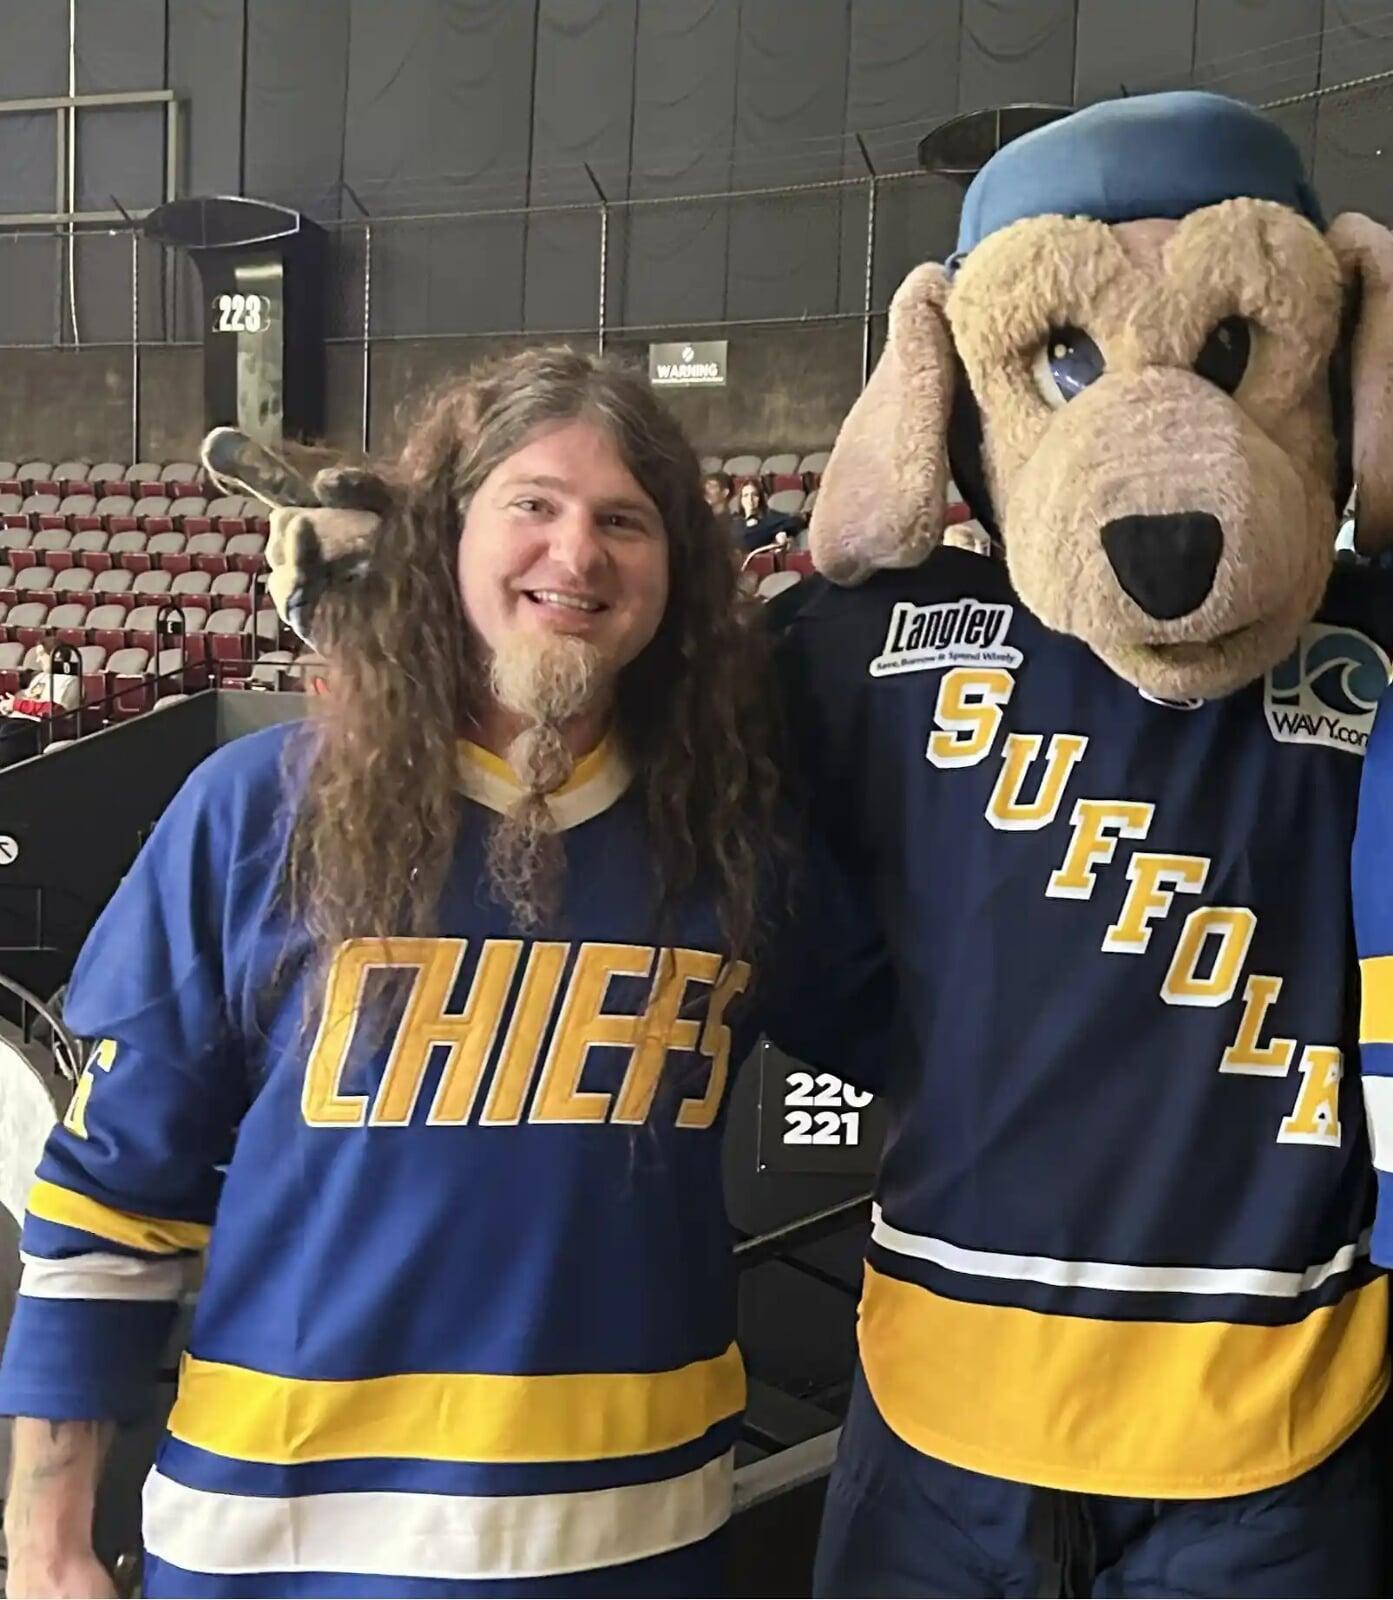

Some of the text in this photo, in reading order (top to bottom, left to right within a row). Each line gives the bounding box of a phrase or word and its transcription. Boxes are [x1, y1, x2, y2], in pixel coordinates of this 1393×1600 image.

[218, 294, 262, 332] 223
[657, 363, 719, 378] WARNING
[890, 604, 1006, 653] Langley
[926, 667, 1344, 1147] SUFFOLK
[301, 937, 751, 1127] CHIEFS
[783, 1110, 859, 1145] 221
